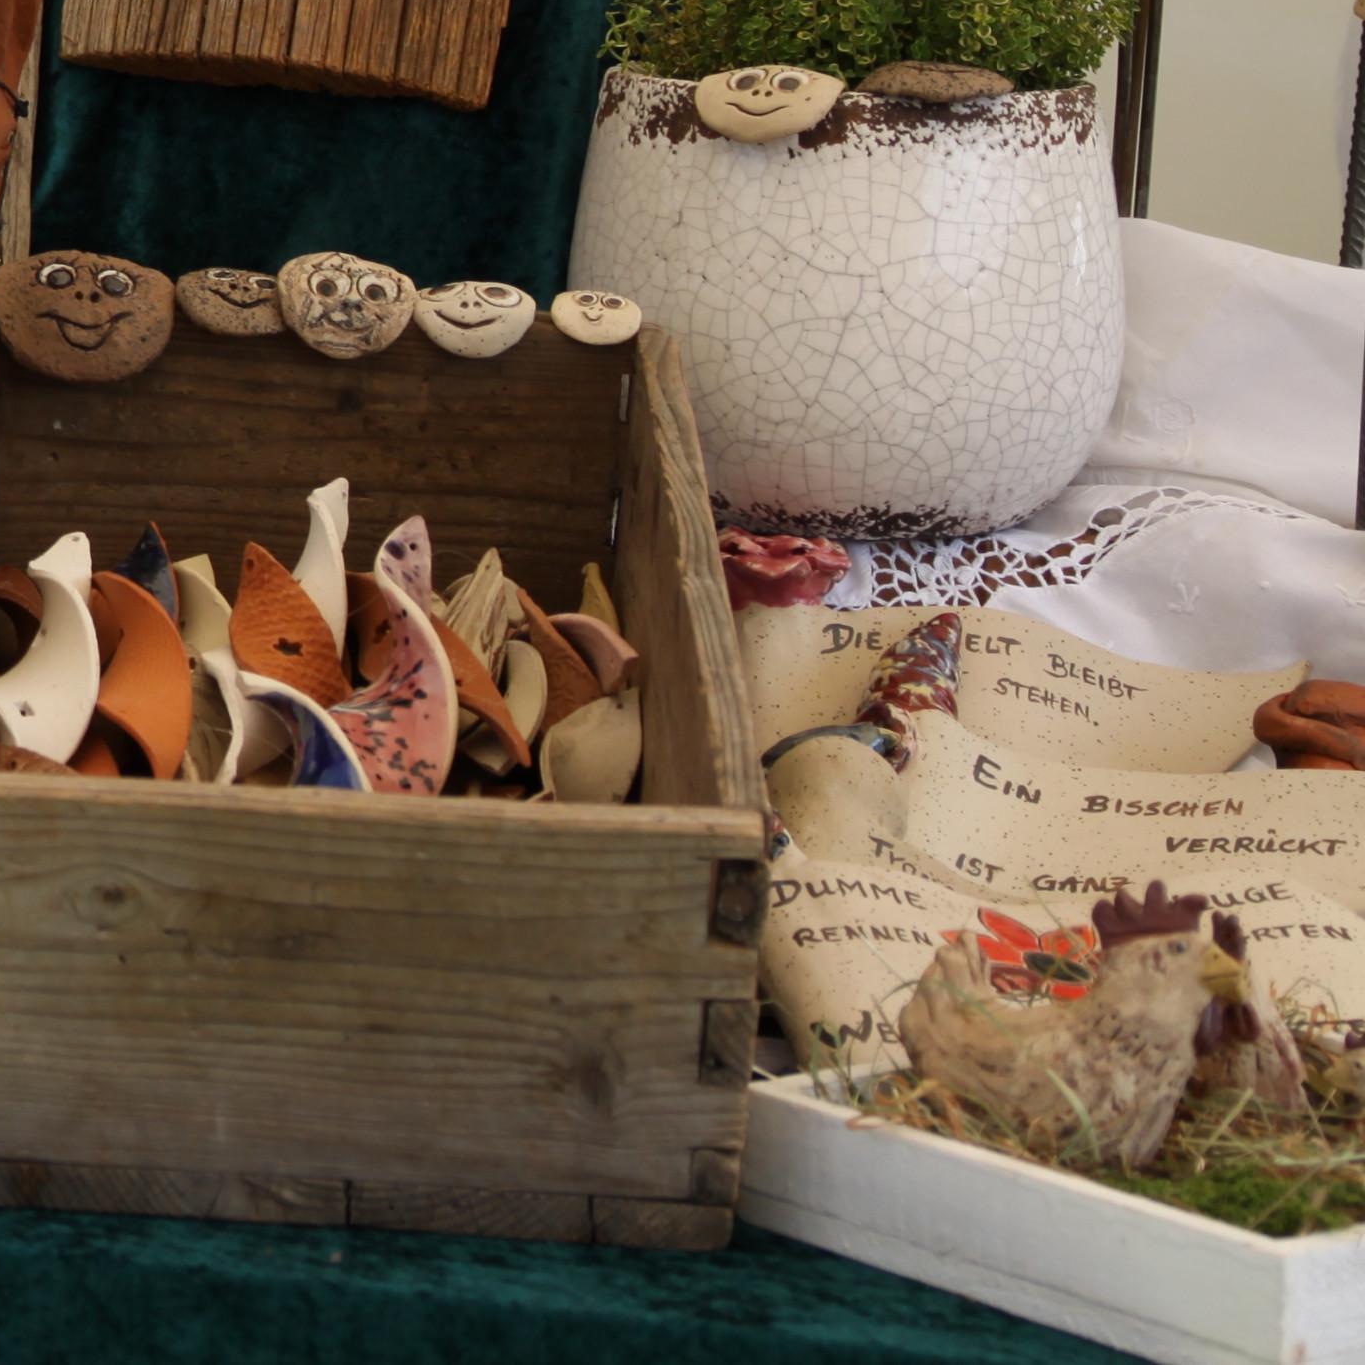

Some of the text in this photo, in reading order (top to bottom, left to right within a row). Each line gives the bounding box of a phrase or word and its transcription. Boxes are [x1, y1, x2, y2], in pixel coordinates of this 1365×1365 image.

[820, 623, 1148, 700] DIE ELT BLEIBT
[973, 754, 1245, 818] EIN BISSCHEN
[955, 852, 1005, 884] IST
[1031, 874, 1135, 894] GANZ
[769, 877, 927, 910] DUMME
[1184, 882, 1294, 910] UGE
[792, 924, 934, 948] RENNEN
[1244, 923, 1354, 942] RTEN
